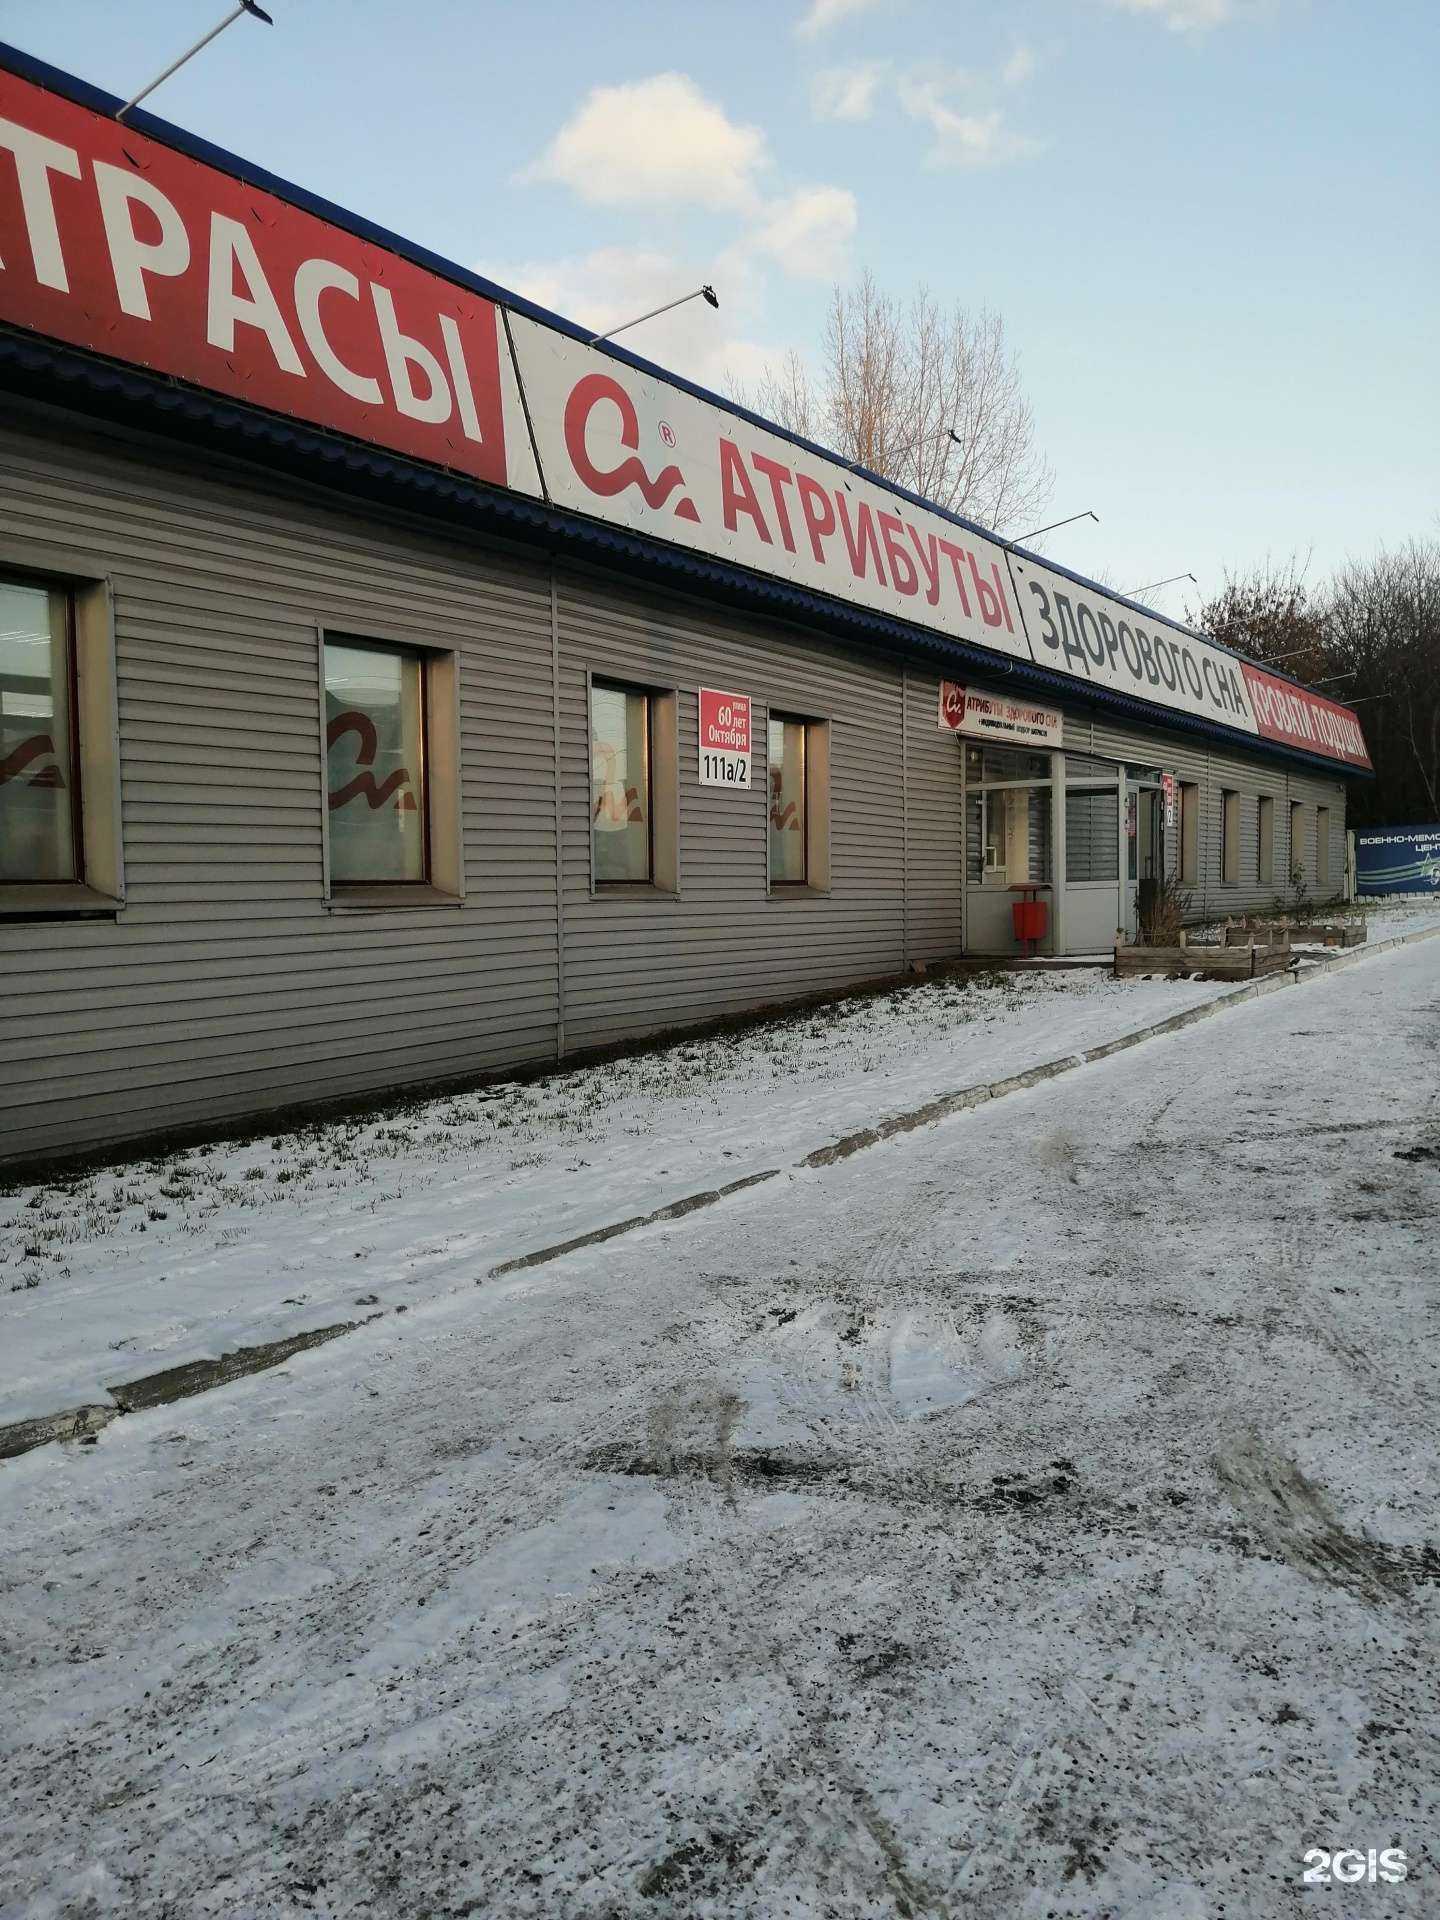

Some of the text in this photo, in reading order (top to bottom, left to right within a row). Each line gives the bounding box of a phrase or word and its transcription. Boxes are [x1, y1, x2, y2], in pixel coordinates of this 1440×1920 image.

[0, 117, 482, 443] ТРАСЫ
[719, 436, 1015, 634] АТРИБУТЫ
[1029, 581, 1248, 717] ЗДОРОВОГО СНА
[708, 724, 747, 749] Октября
[718, 706, 747, 729] 60 лет
[1247, 678, 1368, 759] КРОВАТИ ПОДУШКИ
[704, 754, 747, 783] 111а/2
